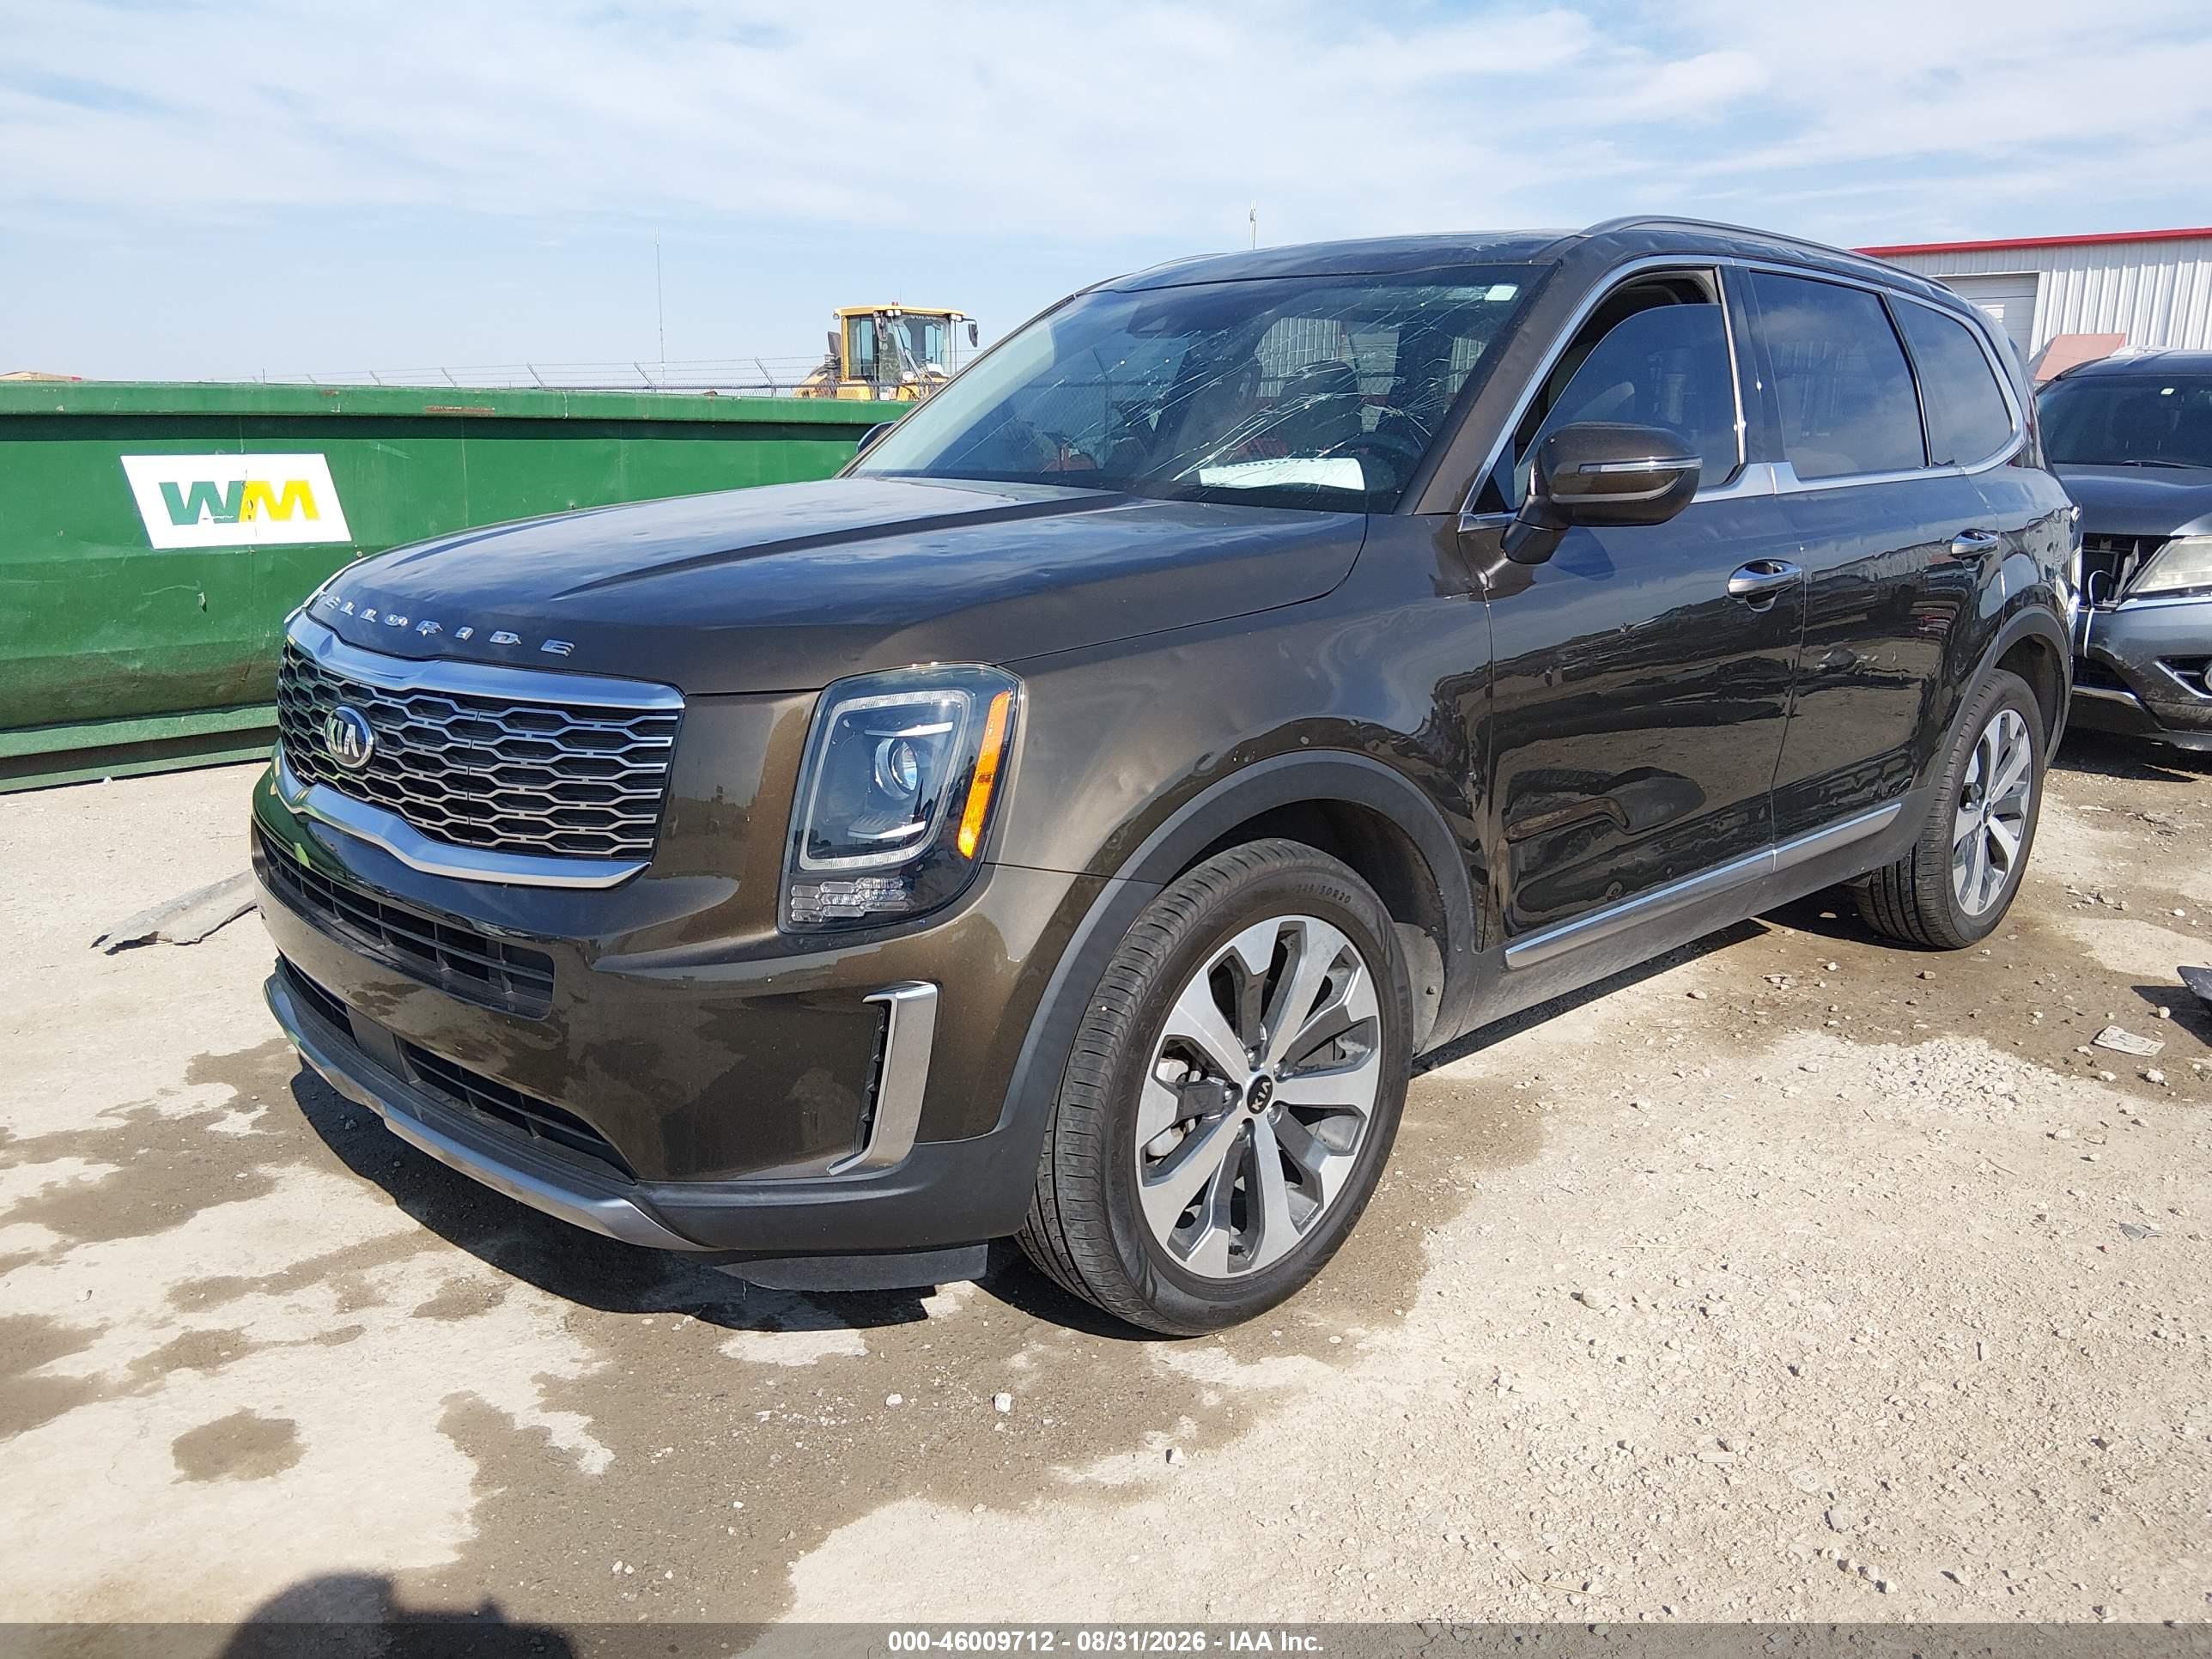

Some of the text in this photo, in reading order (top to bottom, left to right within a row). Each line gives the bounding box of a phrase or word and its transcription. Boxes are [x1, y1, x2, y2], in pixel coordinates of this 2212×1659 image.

[158, 480, 321, 526] WM
[327, 717, 361, 758] KIA
[1250, 1081, 1272, 1111] KIA
